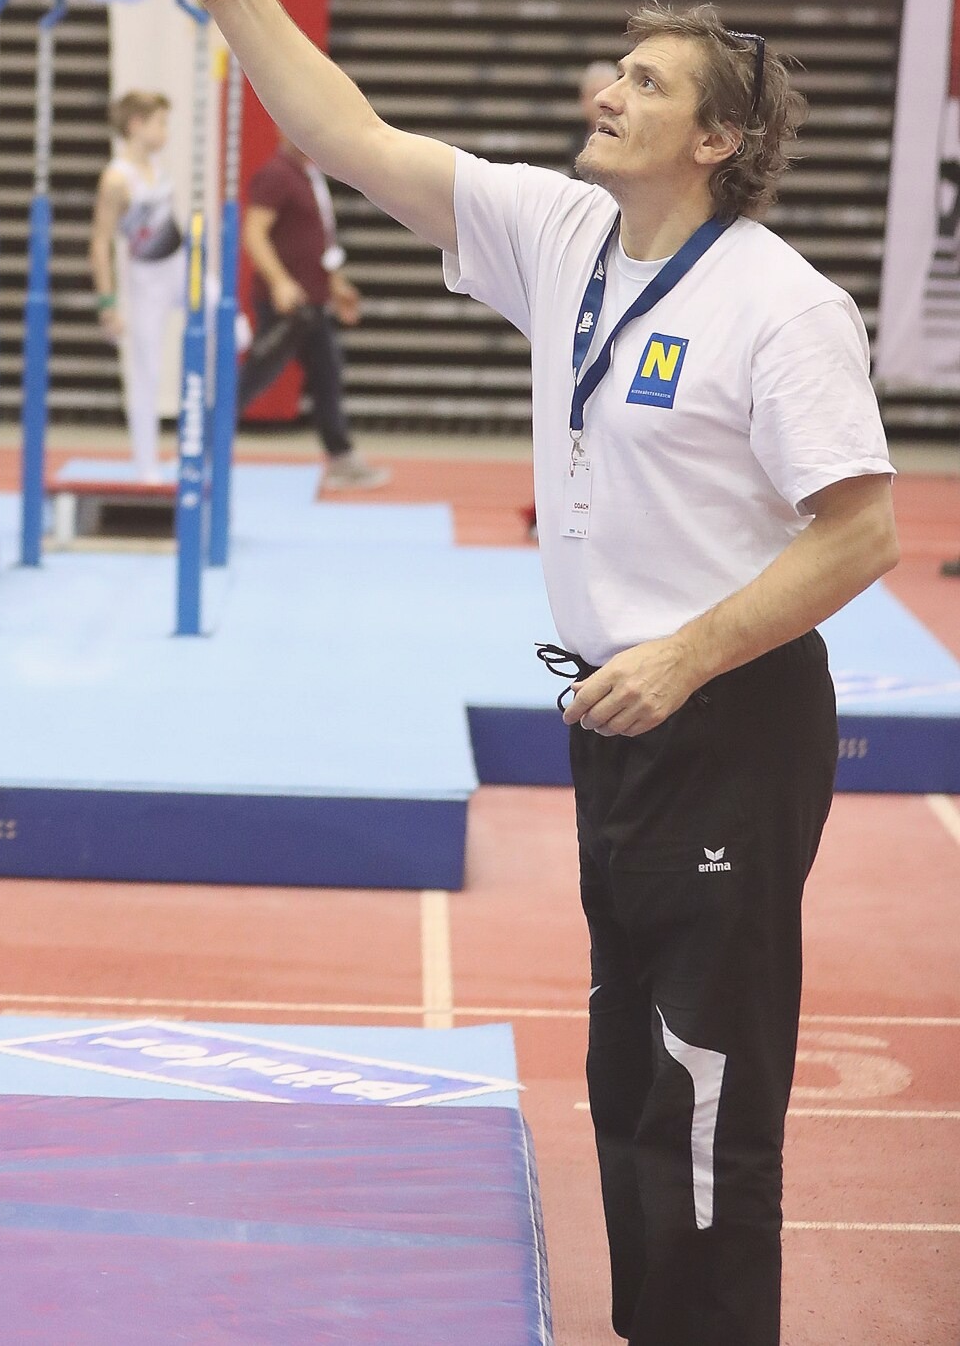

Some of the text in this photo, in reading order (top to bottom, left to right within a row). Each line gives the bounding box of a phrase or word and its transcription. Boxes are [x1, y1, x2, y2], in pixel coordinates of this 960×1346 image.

[577, 311, 594, 334] Tips
[640, 340, 682, 382] N
[573, 502, 589, 510] COACH
[698, 861, 732, 873] erima
